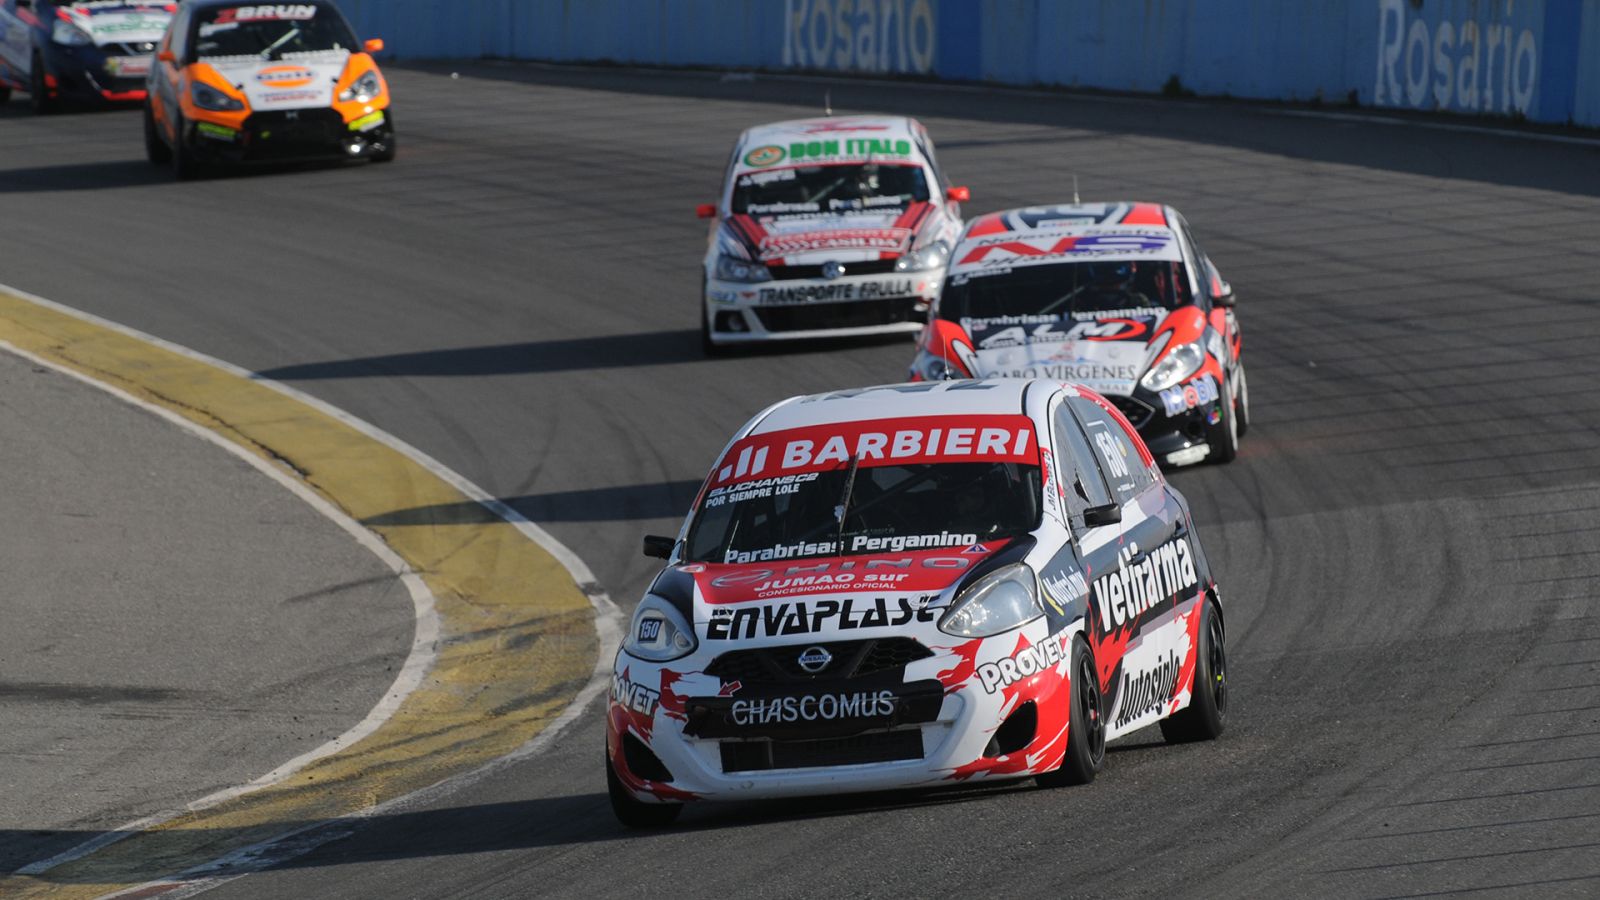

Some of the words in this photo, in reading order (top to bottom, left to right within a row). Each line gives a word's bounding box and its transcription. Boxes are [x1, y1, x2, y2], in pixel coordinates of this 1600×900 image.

[782, 0, 937, 72] Rosario
[1375, 0, 1537, 116] Rosario
[790, 141, 838, 158] DON
[846, 138, 910, 156] ITALO
[759, 283, 854, 302] TRANSPORTE
[960, 313, 1058, 325] Parabrisas
[781, 428, 1030, 469] BARBIERI
[705, 496, 726, 509] POR
[729, 487, 772, 504] SIEMPRE
[776, 483, 800, 496] LOLE
[851, 531, 977, 552] Pergamino
[784, 556, 970, 577] HINO
[754, 574, 855, 592] JUMAO
[863, 572, 909, 583] sur
[758, 582, 850, 598] CONCESIONARIO
[853, 582, 896, 590] OFICIAL
[640, 619, 661, 639] 150
[800, 654, 830, 663] NISSAN
[977, 634, 1069, 694] PROVET
[732, 690, 895, 725] CHASCOMUS
